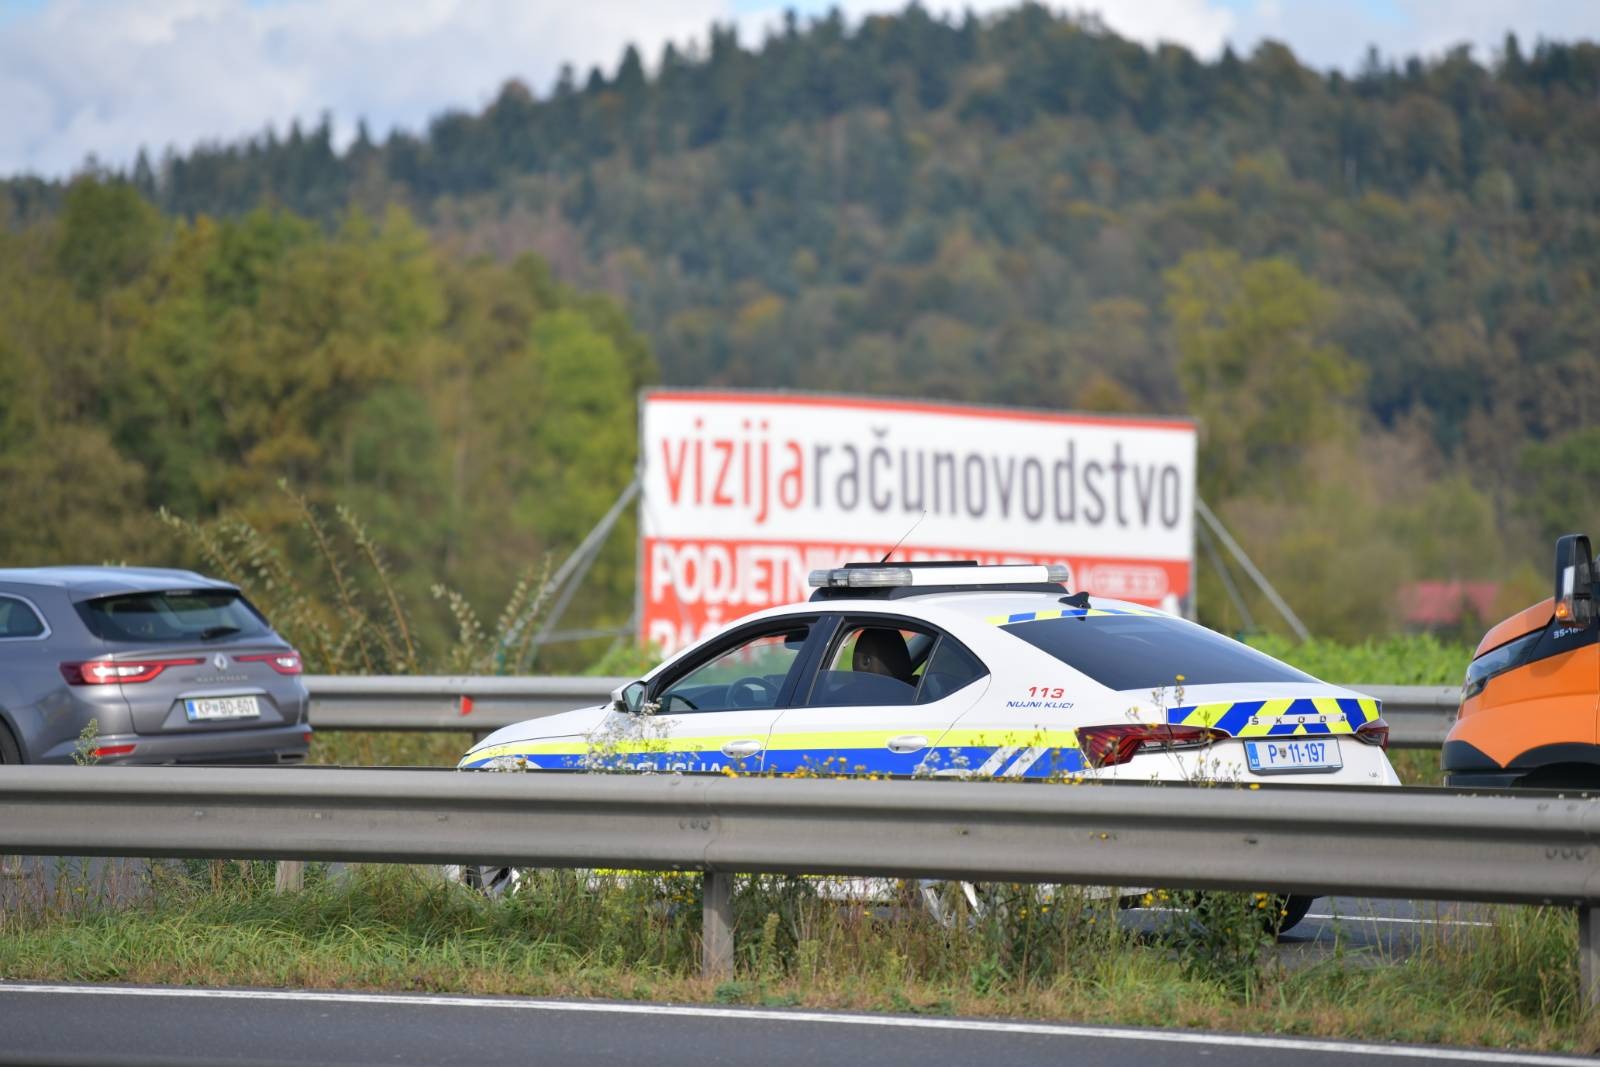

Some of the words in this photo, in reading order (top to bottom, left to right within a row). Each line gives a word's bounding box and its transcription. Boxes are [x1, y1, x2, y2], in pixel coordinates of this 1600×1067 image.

[661, 420, 1182, 530] vizijaračunovodstvo
[1028, 686, 1065, 699] 113
[1006, 700, 1042, 708] NUJNI
[1267, 744, 1278, 764] P
[1288, 743, 1325, 763] 11-197
